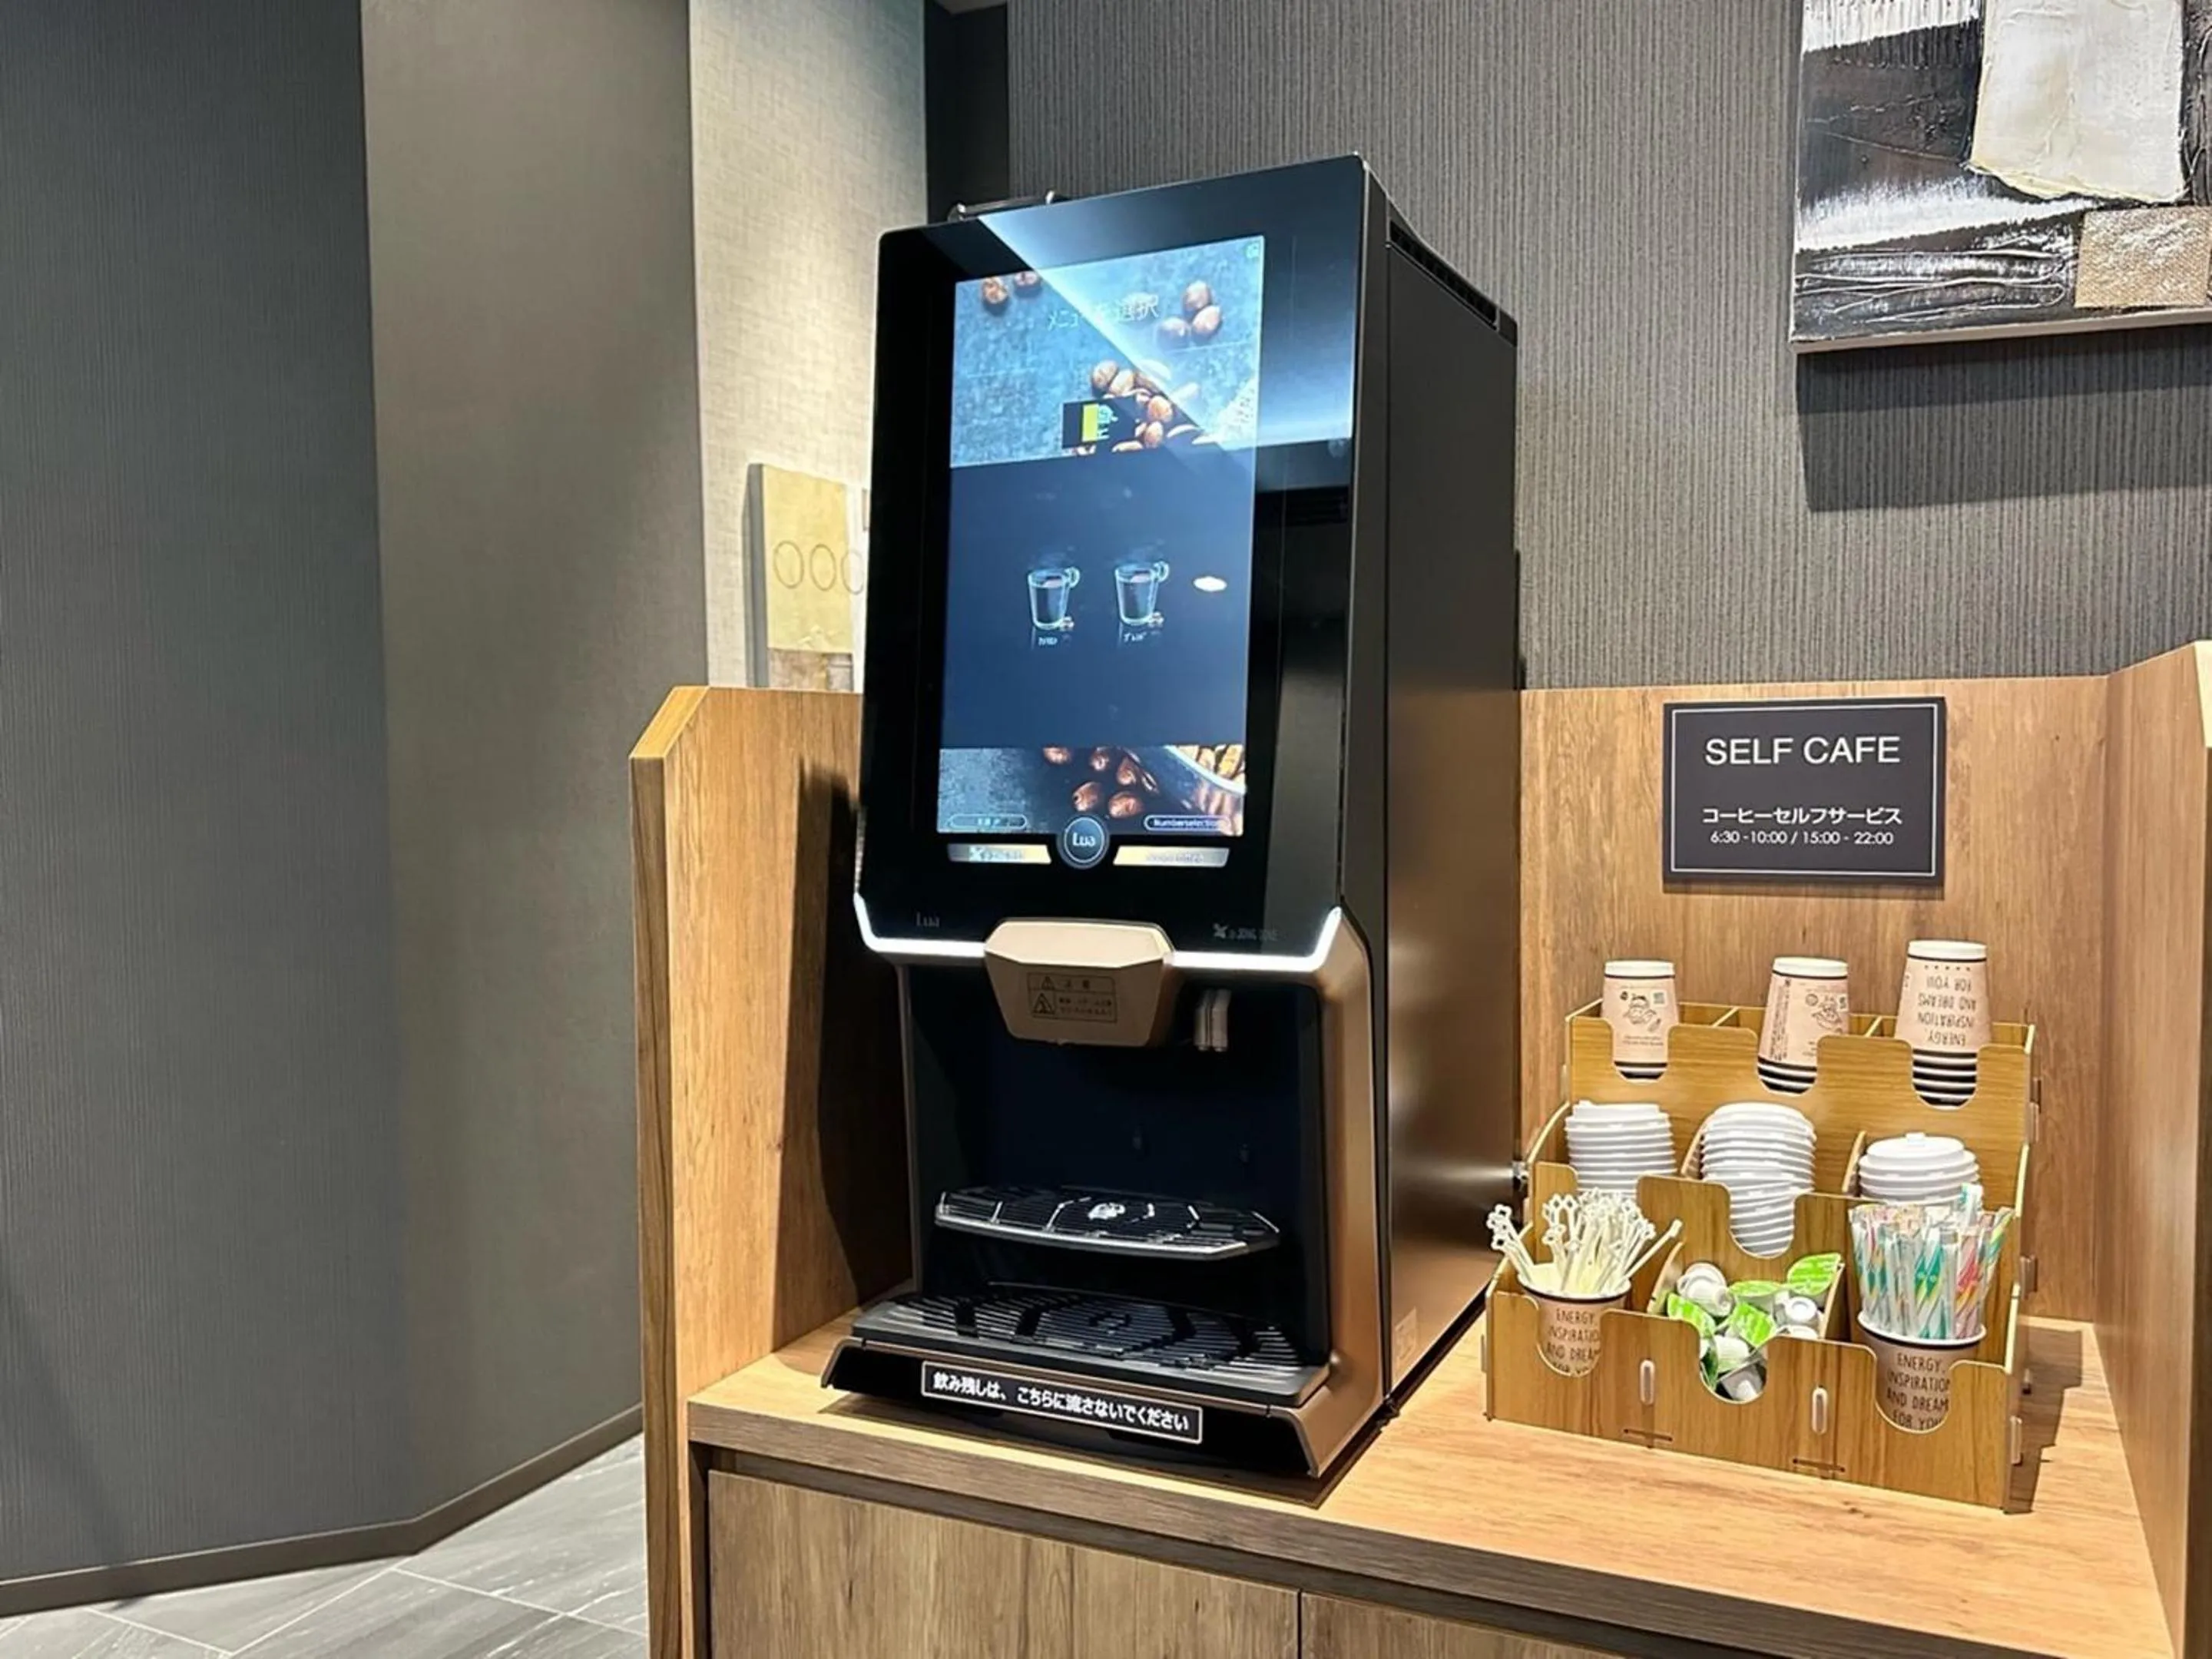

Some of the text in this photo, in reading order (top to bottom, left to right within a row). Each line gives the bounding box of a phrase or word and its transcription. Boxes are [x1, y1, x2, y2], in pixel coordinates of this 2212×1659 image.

[1704, 736, 1901, 766] SELF CAFE
[1702, 806, 1902, 825] コーヒーセルフサービス
[1072, 831, 1096, 847] Lua
[1710, 830, 1740, 845] 6:30
[1803, 830, 1842, 845] 15:00
[1853, 830, 1895, 846] 22:00
[1912, 1395, 1949, 1412] DREAM
